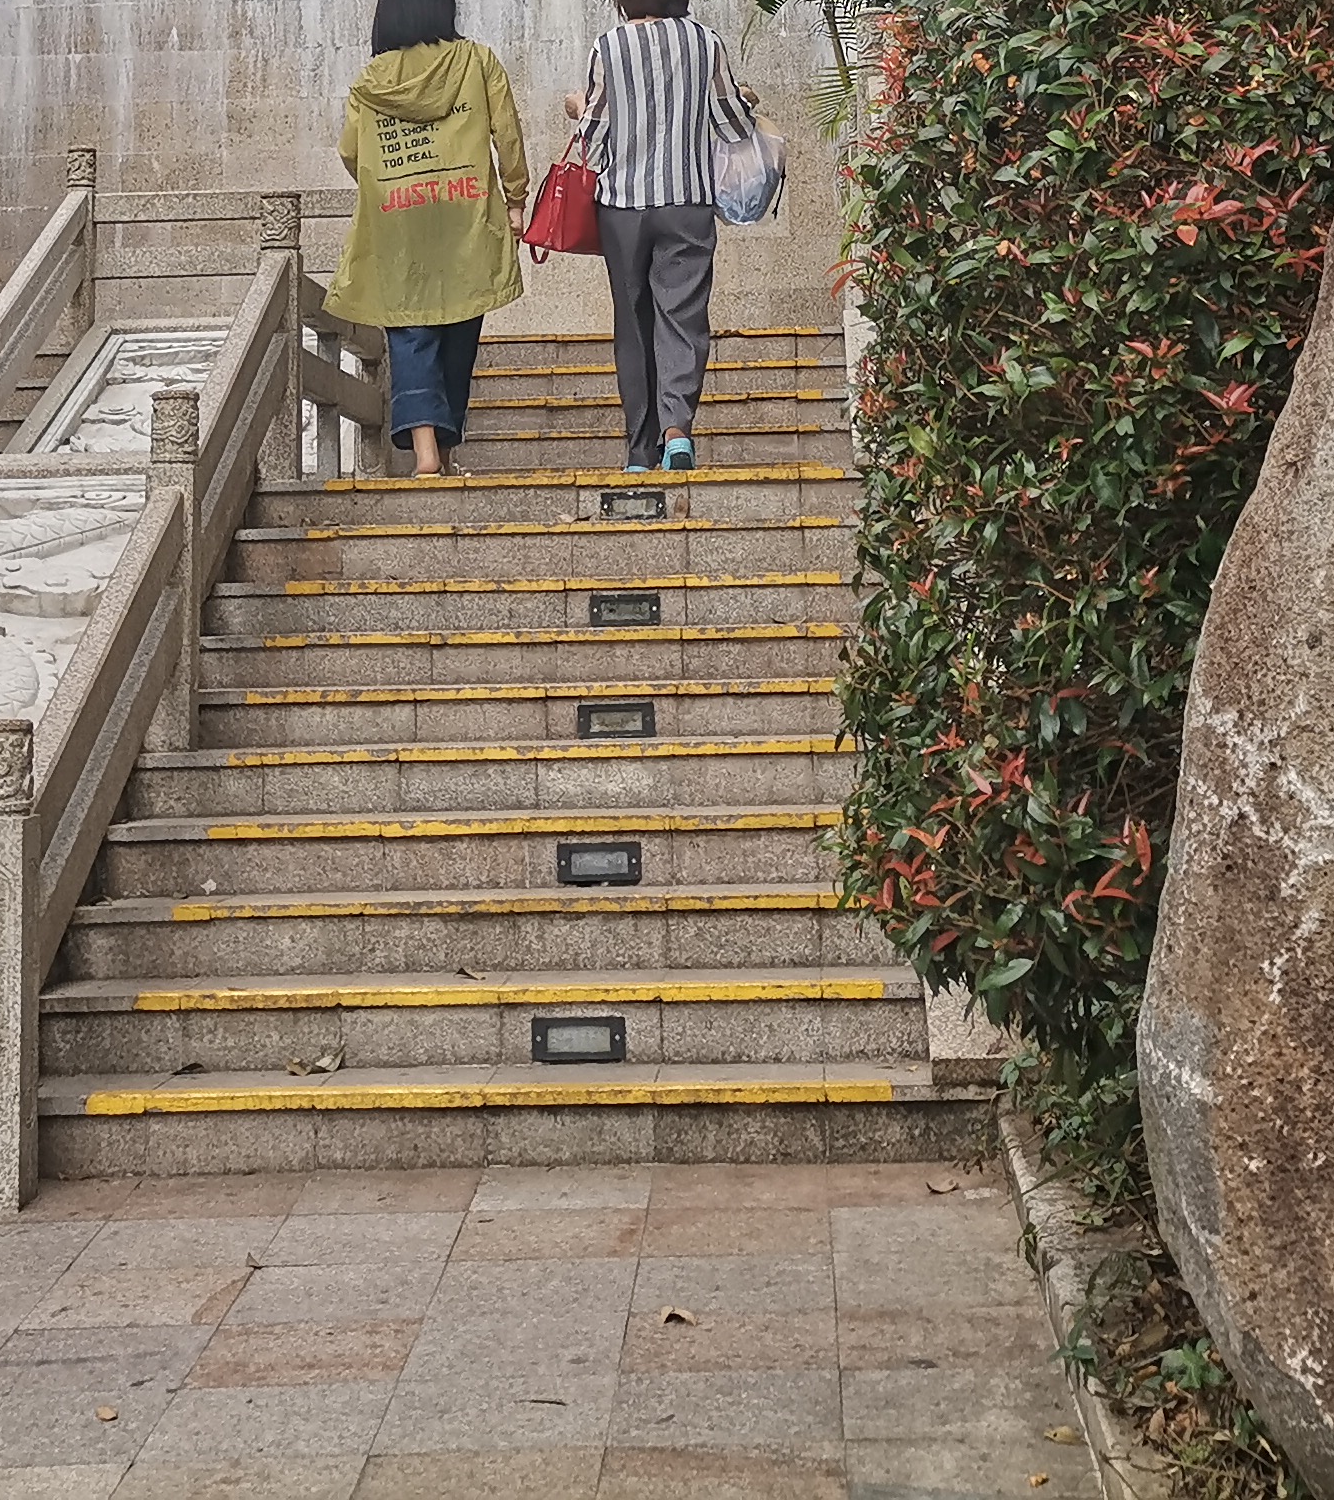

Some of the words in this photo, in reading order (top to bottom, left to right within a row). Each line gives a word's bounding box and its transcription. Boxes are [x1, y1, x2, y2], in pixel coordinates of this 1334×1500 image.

[377, 130, 398, 141] TOO
[380, 142, 401, 154] TOO
[405, 137, 435, 149] LOUD.
[382, 157, 403, 169] TOO
[407, 150, 439, 164] REAL.
[379, 181, 439, 212] JUST
[447, 177, 489, 201] ME.
